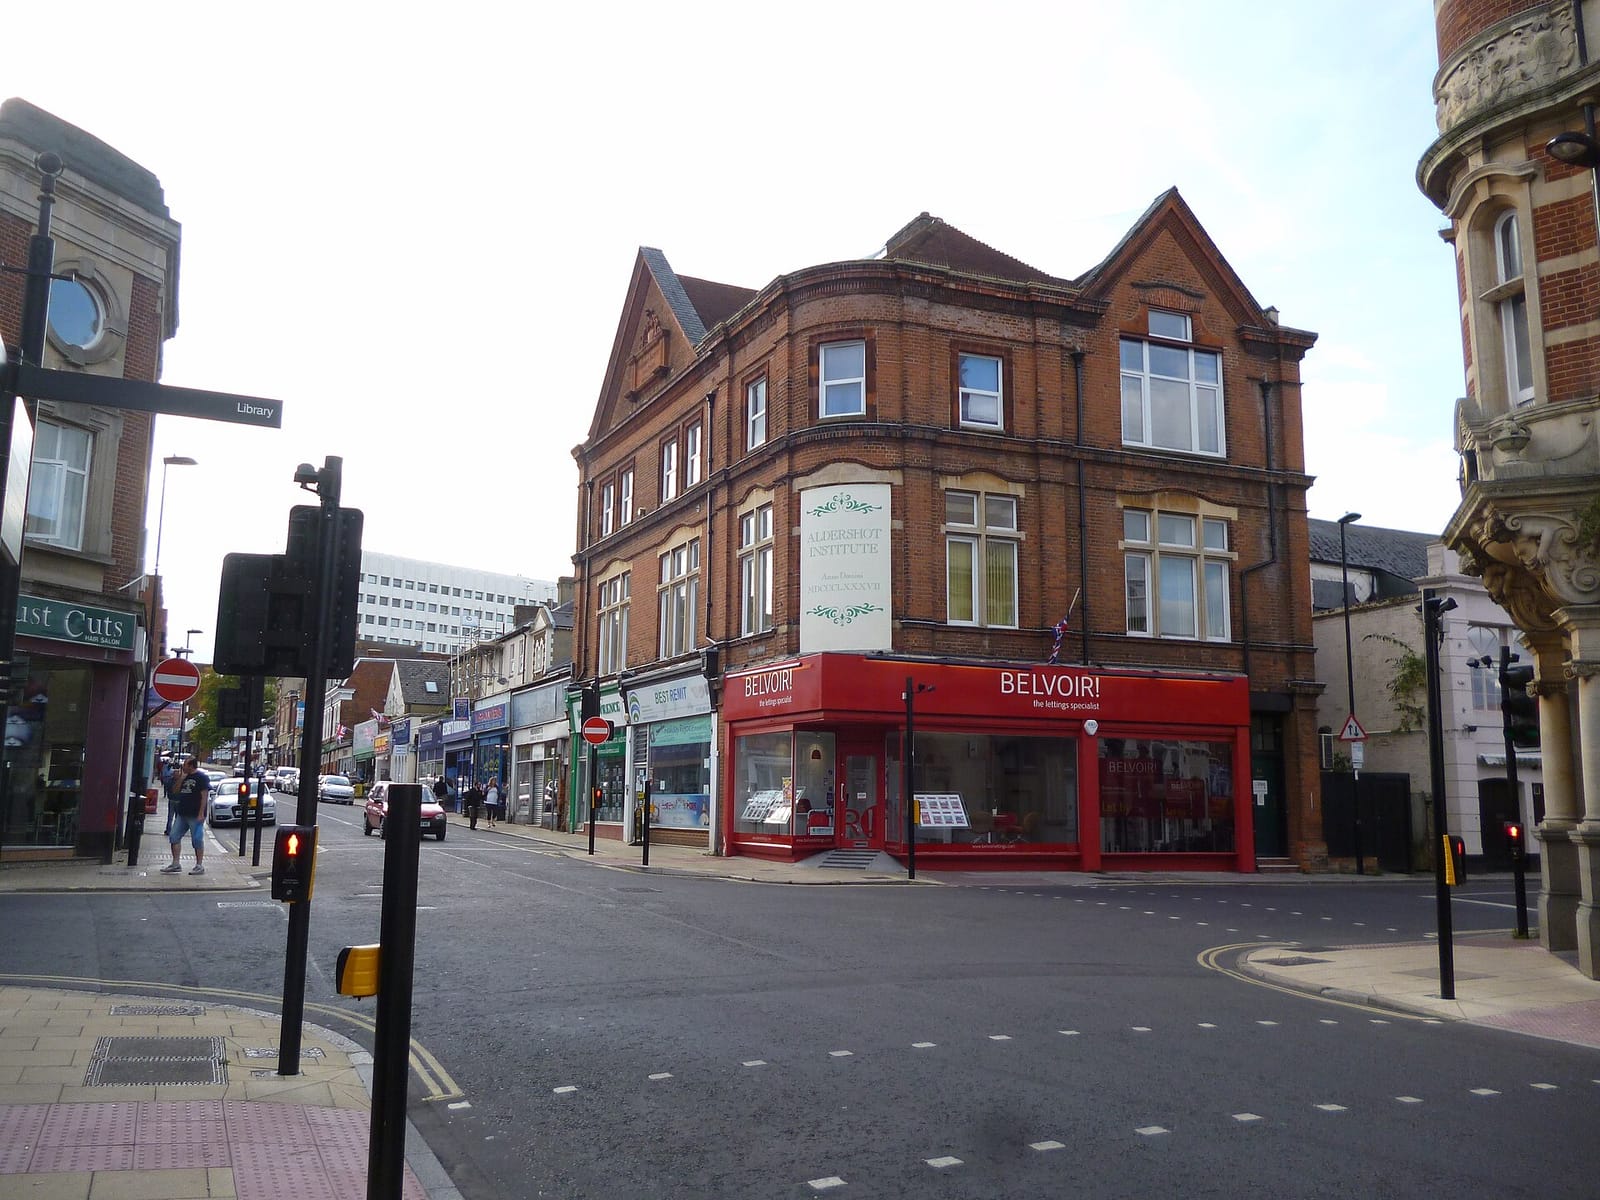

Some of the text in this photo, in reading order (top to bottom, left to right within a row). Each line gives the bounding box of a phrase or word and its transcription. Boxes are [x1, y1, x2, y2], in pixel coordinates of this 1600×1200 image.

[237, 402, 274, 418] Library
[807, 528, 883, 544] ALDERSHOT
[809, 543, 879, 558] INSTITUTE
[15, 605, 123, 638] ust Cuts
[84, 635, 121, 646] HAIR SALON
[745, 669, 793, 697] BELVOIR!
[1001, 672, 1100, 698] BELVOIR!
[654, 686, 687, 704] BEST REMIT
[1033, 699, 1100, 711] the lettings specialist
[1108, 761, 1158, 774] BELVOIR!
